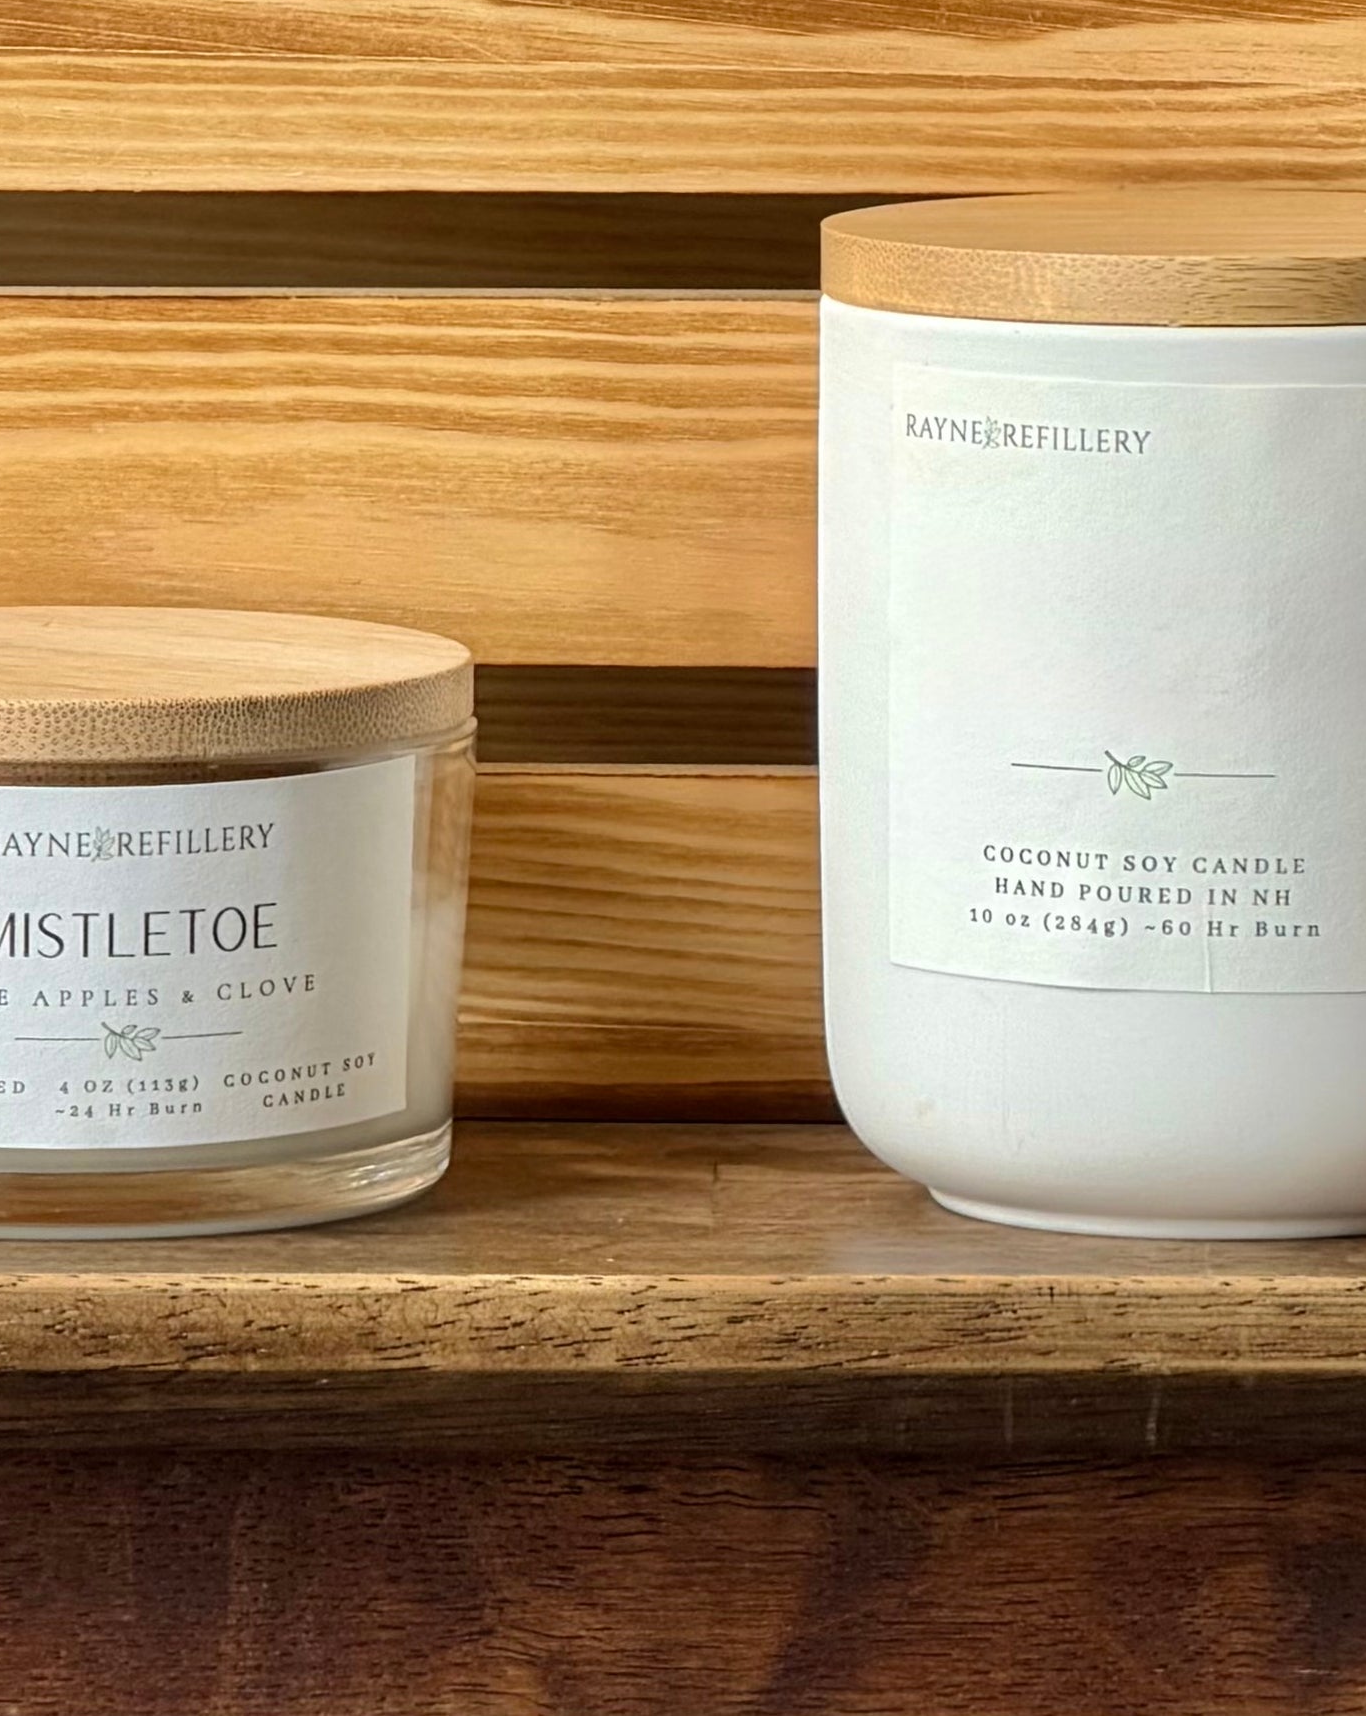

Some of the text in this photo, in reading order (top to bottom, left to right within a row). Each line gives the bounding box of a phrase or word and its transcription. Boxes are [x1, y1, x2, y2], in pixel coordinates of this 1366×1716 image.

[905, 413, 1152, 455] RAYNE REFILLERY
[117, 822, 275, 857] REFILLERY
[983, 844, 1306, 875] COCONUT SOY CANDLE
[995, 876, 1291, 907] HAND POURED IN NH
[969, 907, 1321, 938] 10 oz (284g) ~60 Hr Burn
[32, 987, 159, 1008] APPLES
[181, 990, 194, 1004] &
[216, 973, 315, 1001] CLOVE
[59, 1074, 199, 1095] 4 OZ (113g)
[223, 1052, 375, 1088] COCONUT SOY
[54, 1102, 202, 1119] ~24 Hr Burn
[259, 1083, 346, 1108] CANDLE
